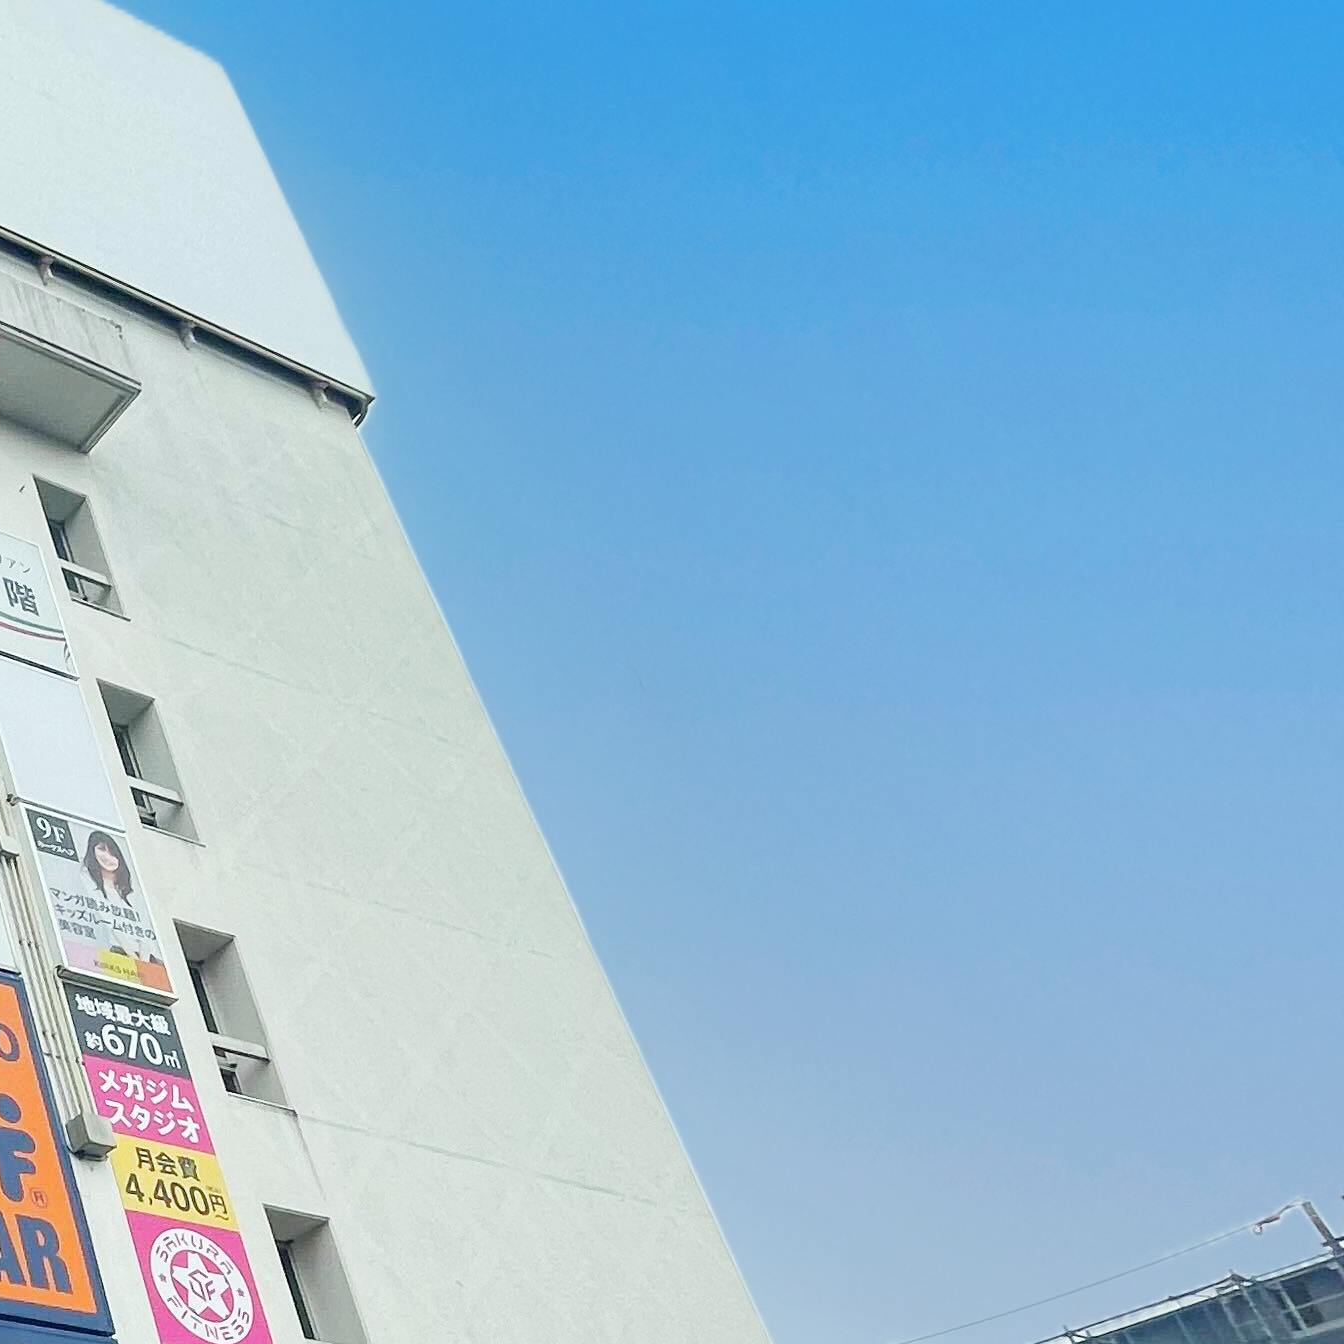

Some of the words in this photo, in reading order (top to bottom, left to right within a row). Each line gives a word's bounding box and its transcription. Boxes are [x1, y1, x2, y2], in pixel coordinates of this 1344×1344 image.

[97, 1069, 196, 1113] メガジム
[104, 1099, 202, 1144] スタジオ
[135, 1146, 201, 1182] 月会費
[155, 1231, 235, 1276] SAKURA
[166, 1295, 251, 1342] FITNESS
